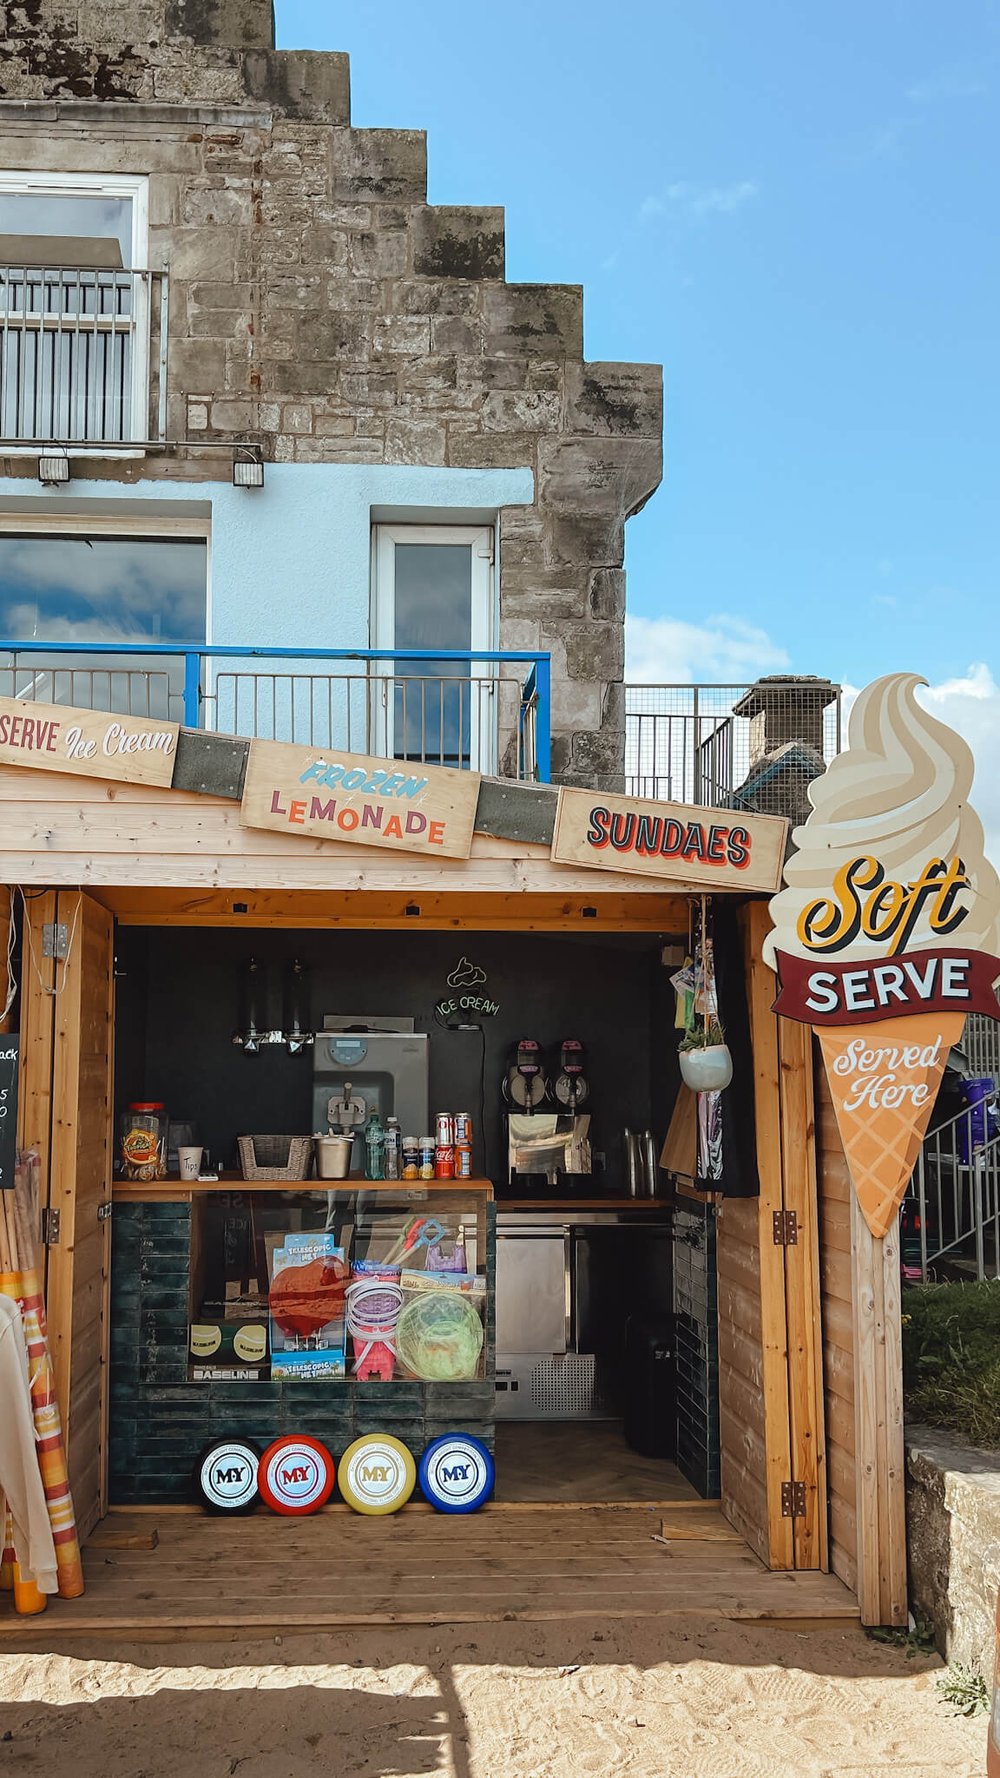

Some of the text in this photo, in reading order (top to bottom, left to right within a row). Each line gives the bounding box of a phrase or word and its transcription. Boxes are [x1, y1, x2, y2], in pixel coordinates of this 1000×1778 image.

[0, 714, 175, 760] SERVE Ice Cream
[299, 760, 430, 799] FROZEN
[270, 790, 446, 845] LEMONADE
[586, 806, 751, 870] SUNDAES
[796, 855, 971, 956] Soft
[804, 957, 974, 1013] SERVE
[436, 995, 500, 1017] ICE CREAM
[833, 1035, 943, 1077] Served
[843, 1073, 932, 1112] Here
[184, 1156, 198, 1171] Tips
[287, 1243, 332, 1256] TELESCOPIC
[193, 1370, 260, 1380] BASELINE
[286, 1362, 331, 1375] TELESCOPIC
